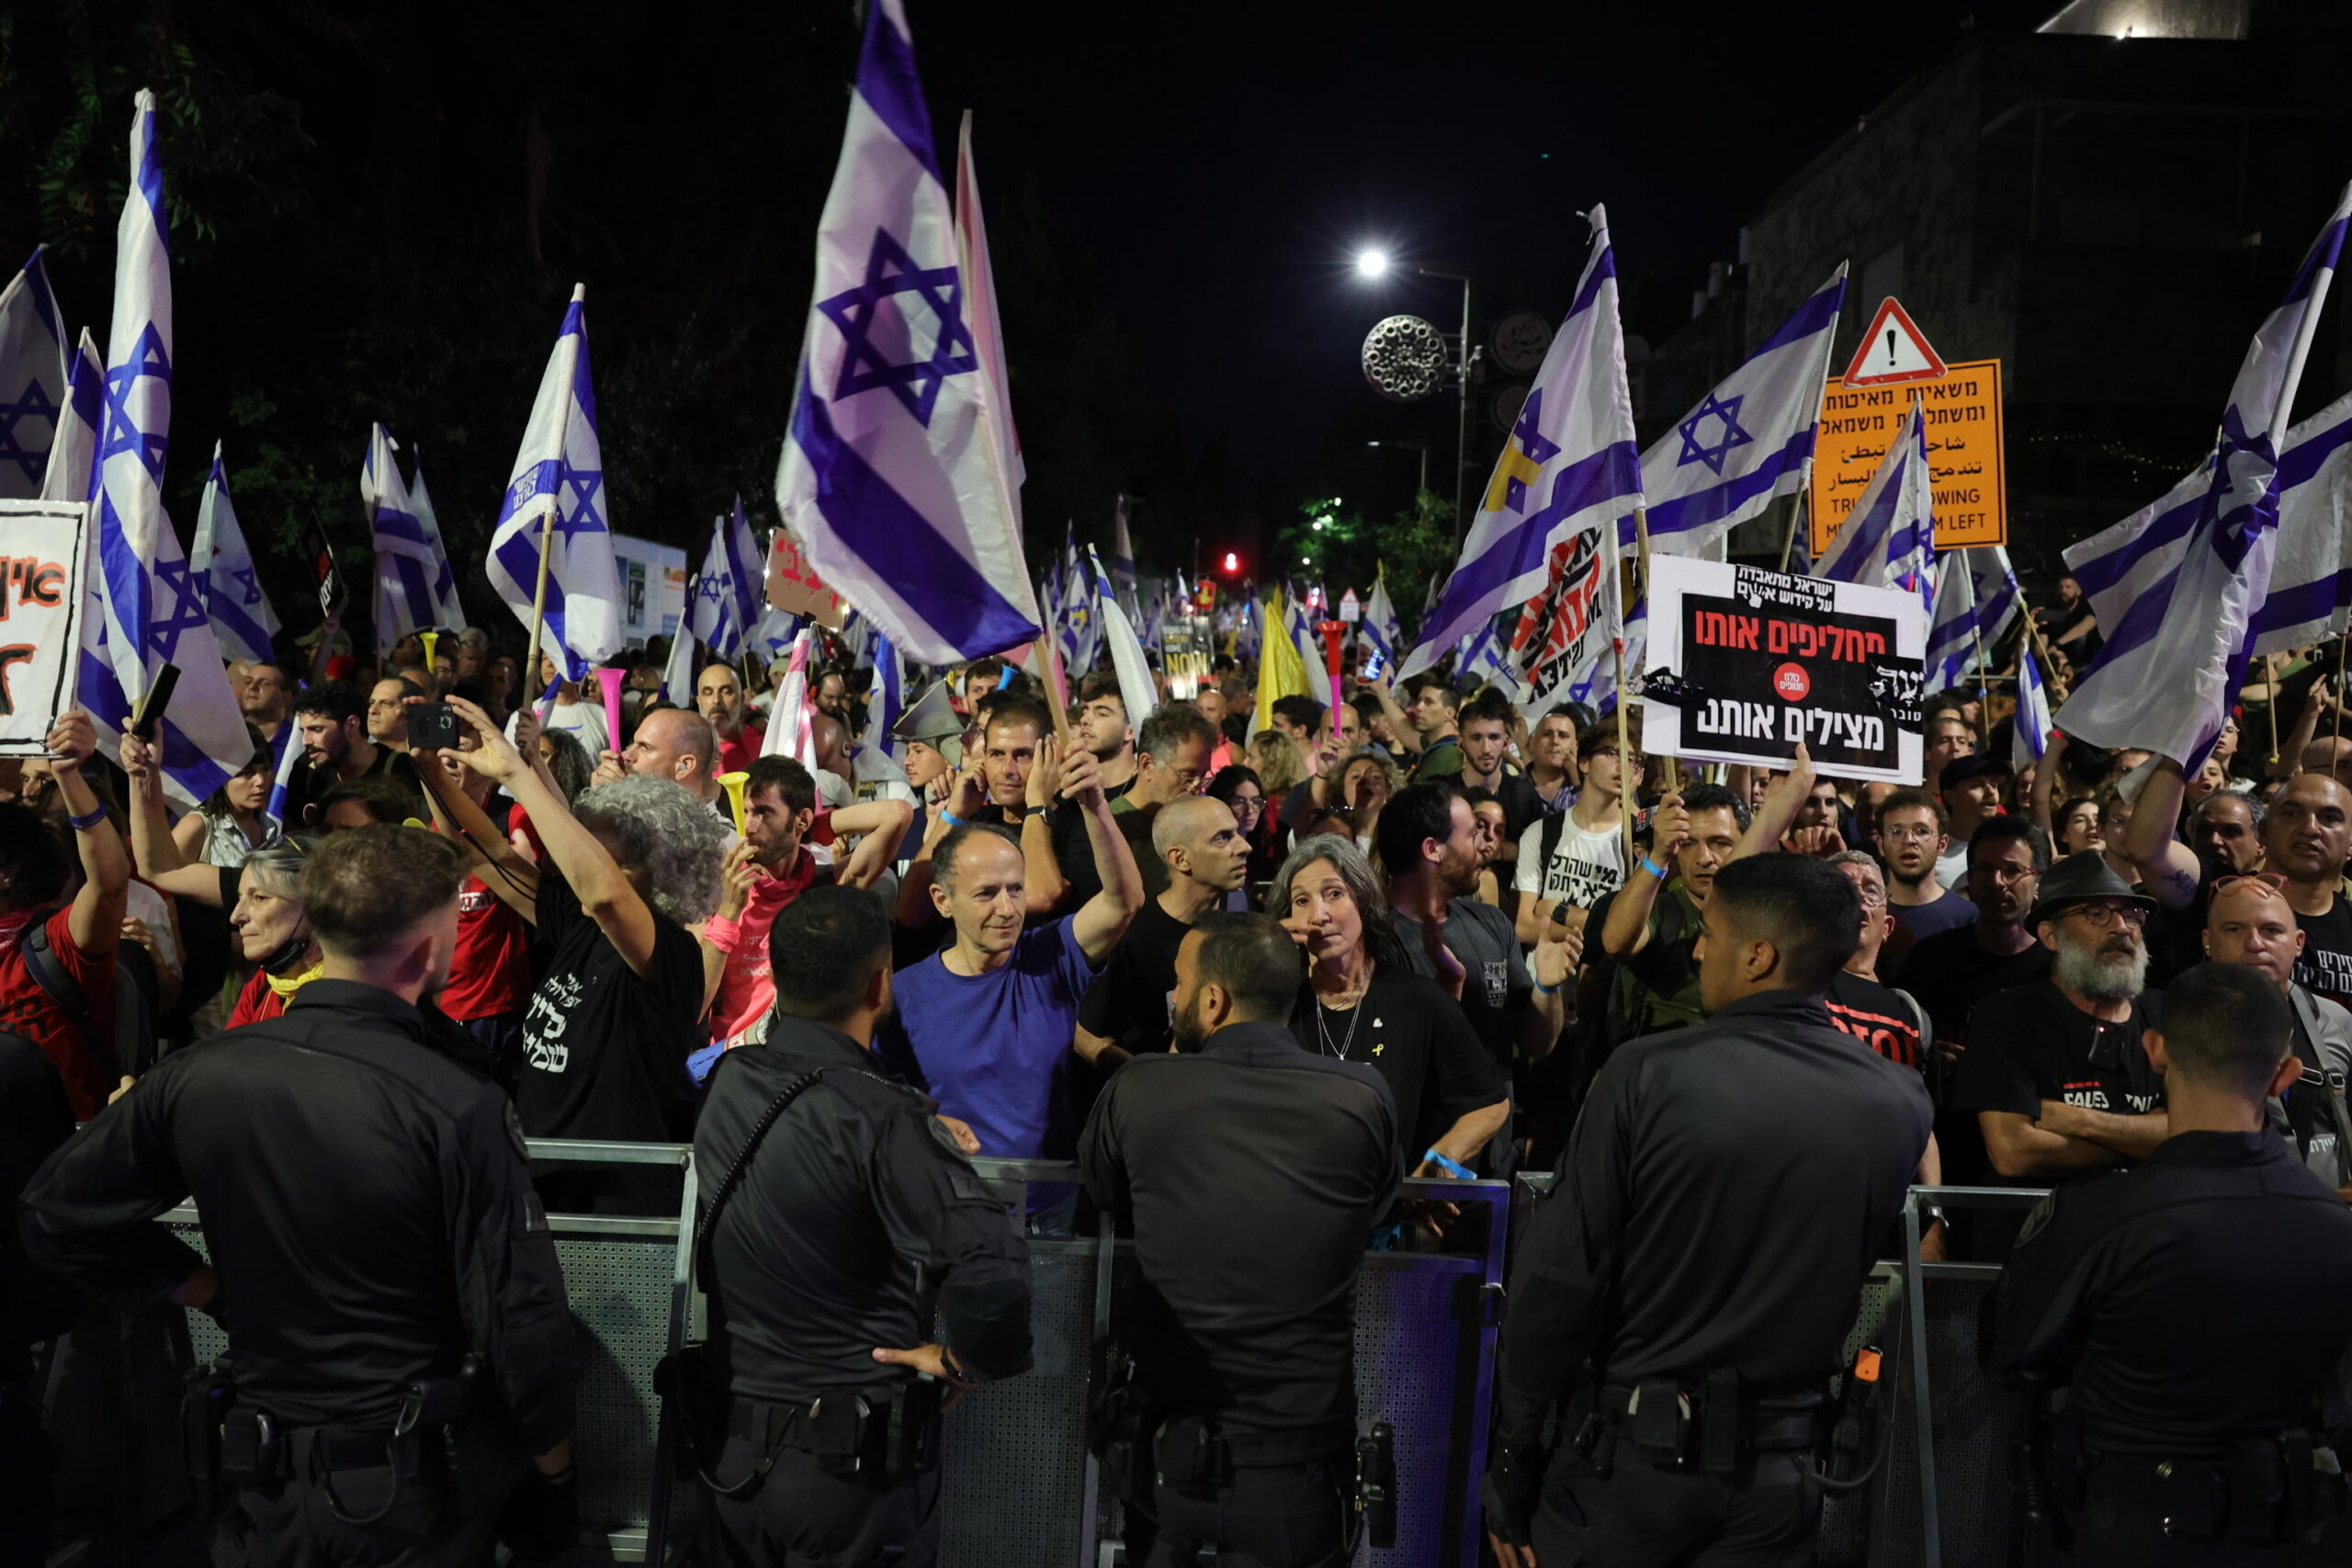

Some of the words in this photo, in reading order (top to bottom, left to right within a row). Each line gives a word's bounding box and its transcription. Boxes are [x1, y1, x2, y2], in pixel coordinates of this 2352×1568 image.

[1826, 389, 1894, 411] מאיטות
[1820, 415, 1884, 434] משמאל
[1896, 405, 1985, 428] ומשתלת
[1949, 513, 1986, 530] LEFT
[1738, 566, 1792, 589] מתאבדת
[1793, 576, 1833, 596] ישראל
[1779, 589, 1814, 609] קידוש
[1816, 596, 1833, 613] על
[1695, 611, 1759, 650] אותו
[1769, 619, 1886, 663] מחליפים
[1166, 652, 1208, 676] NOW
[1891, 708, 1922, 721] טובר
[1784, 707, 1884, 750] מצילים
[1550, 853, 1592, 877] שהרס
